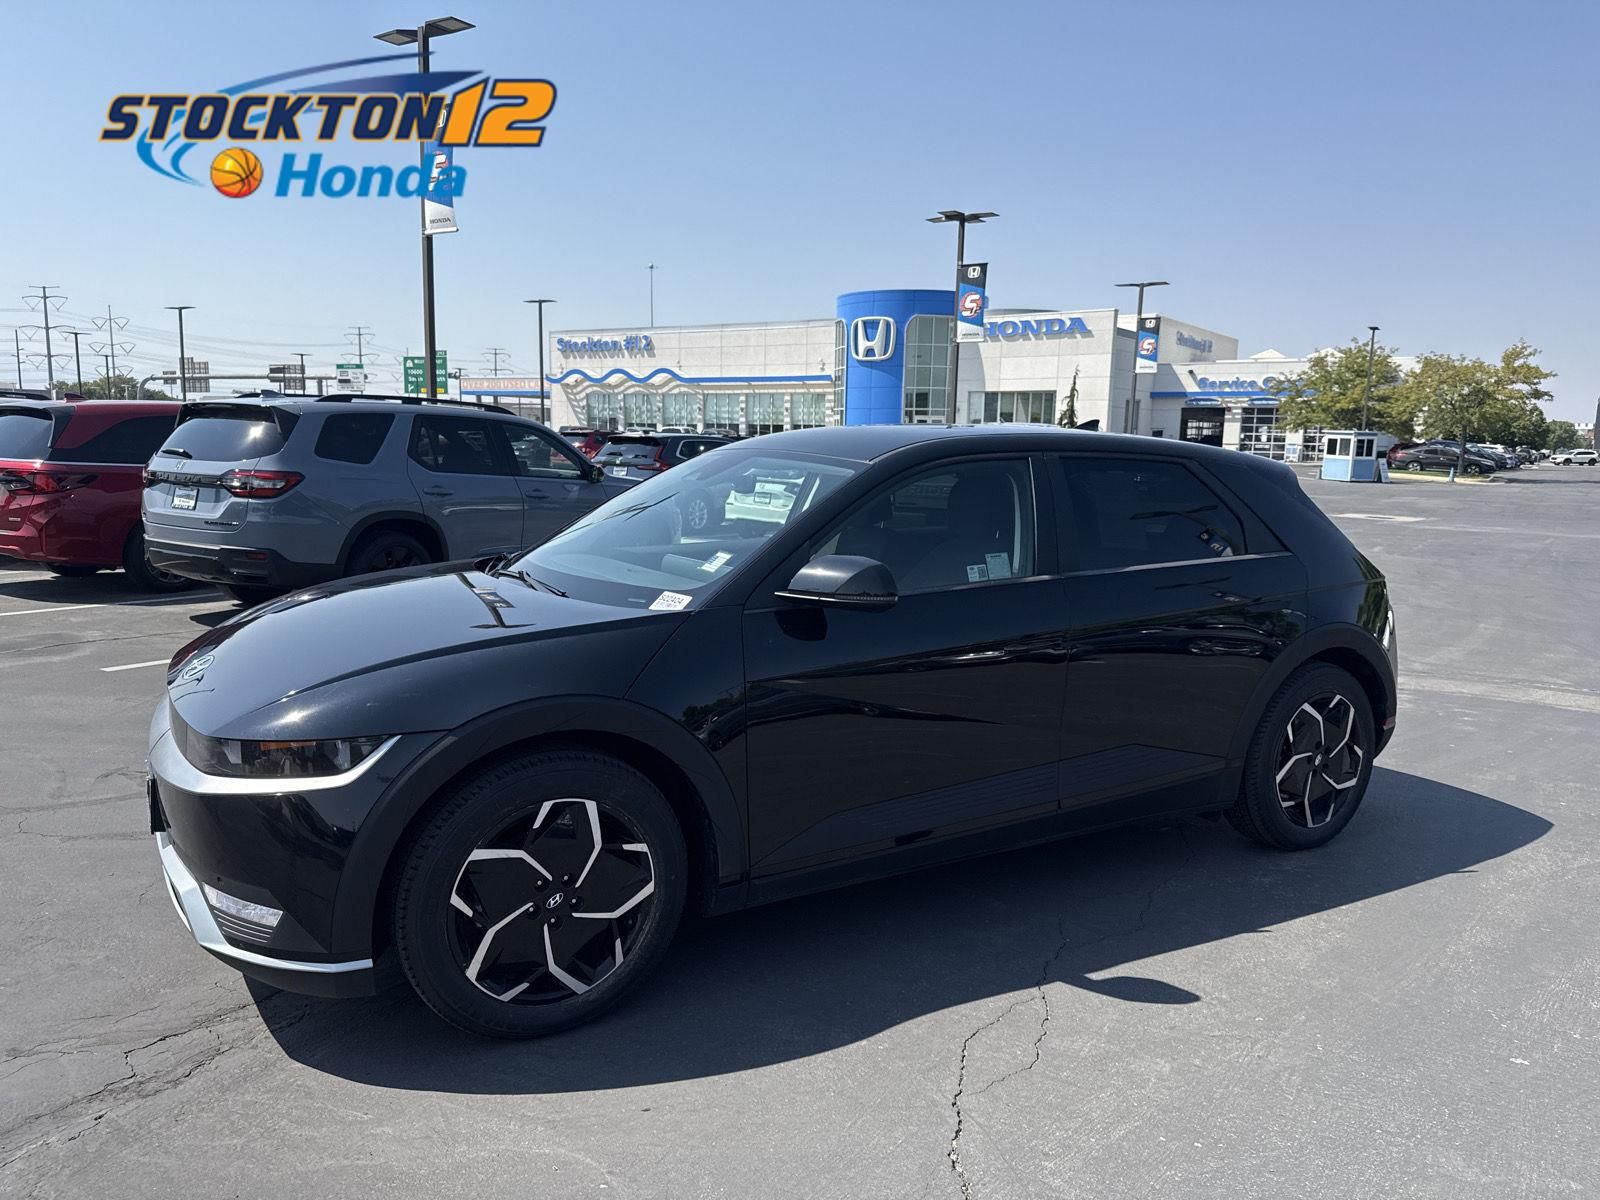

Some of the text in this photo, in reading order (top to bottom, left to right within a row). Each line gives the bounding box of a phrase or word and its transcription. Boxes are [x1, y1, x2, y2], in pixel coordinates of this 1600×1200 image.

[429, 216, 451, 225] HONDA
[983, 317, 1089, 337] HONDA
[556, 336, 620, 353] Stockton
[503, 380, 526, 389] USED
